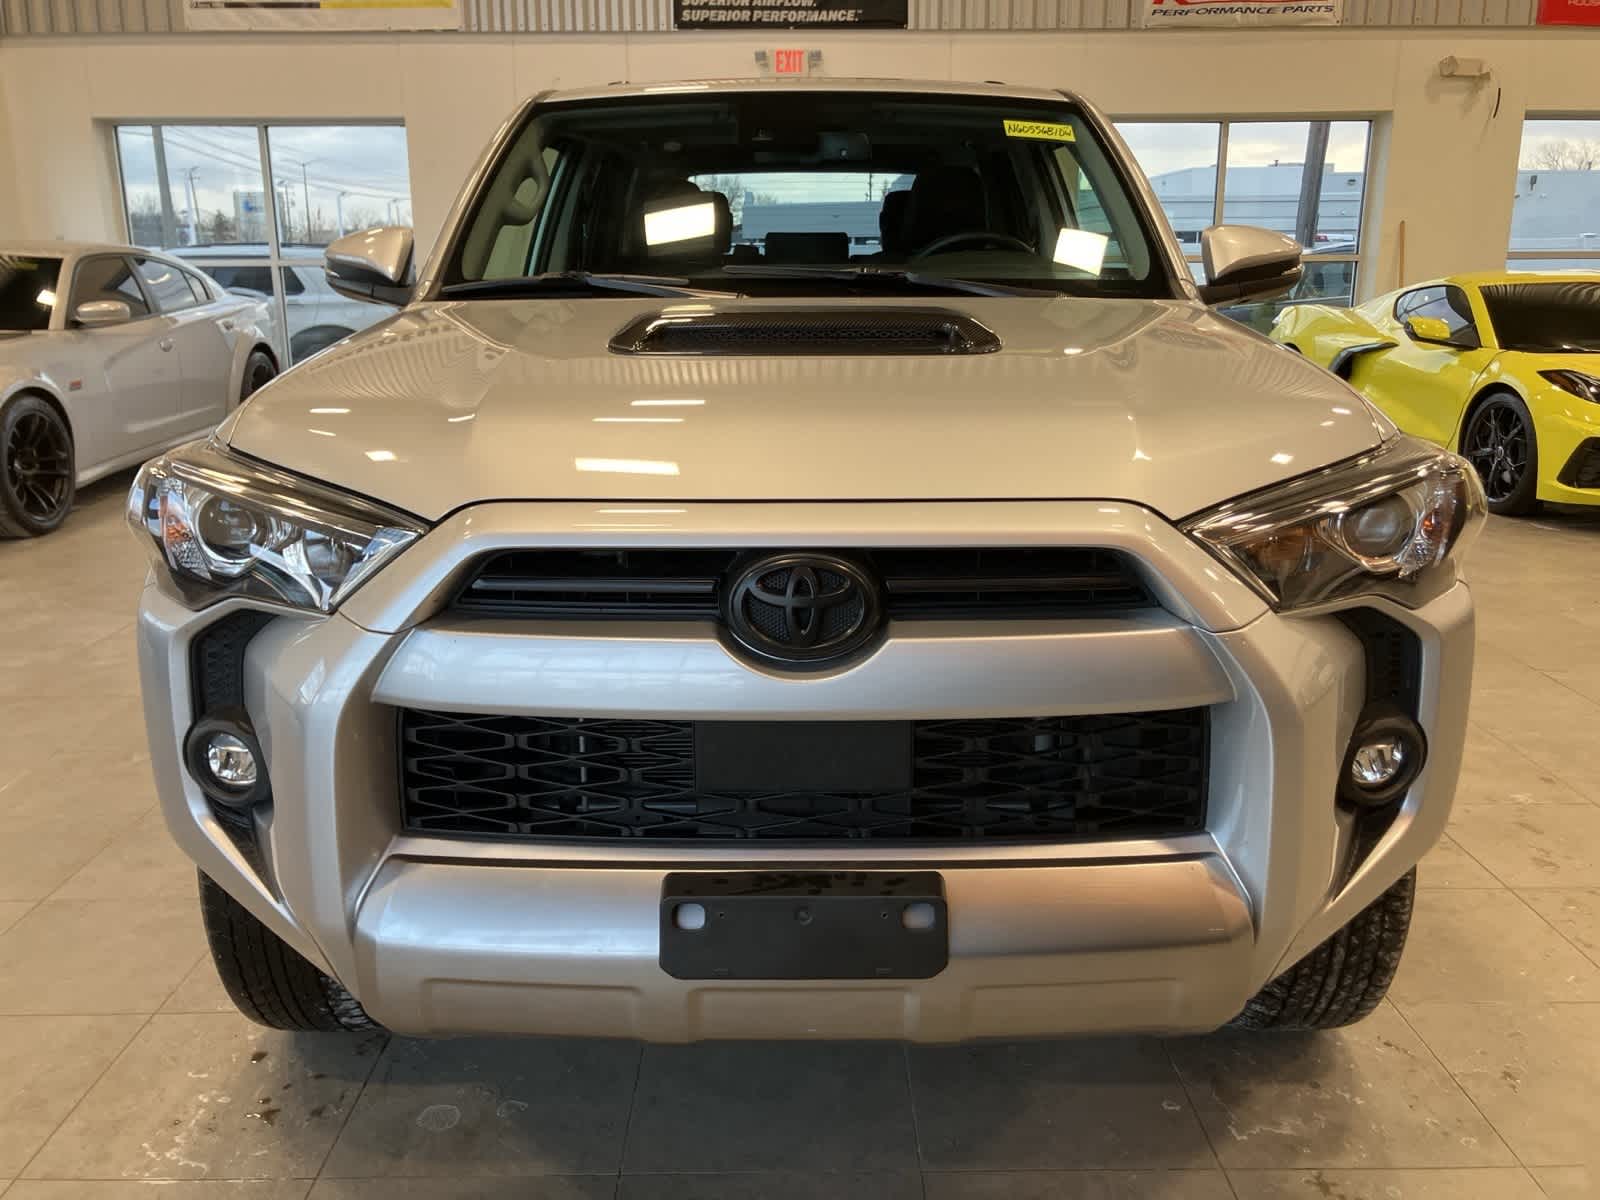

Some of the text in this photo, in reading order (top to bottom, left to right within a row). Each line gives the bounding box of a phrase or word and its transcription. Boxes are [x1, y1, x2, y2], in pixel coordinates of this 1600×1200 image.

[681, 9, 752, 22] SUPERIOR
[1151, 5, 1335, 16] PERFORMANCE PARTS
[775, 48, 804, 73] EXIT
